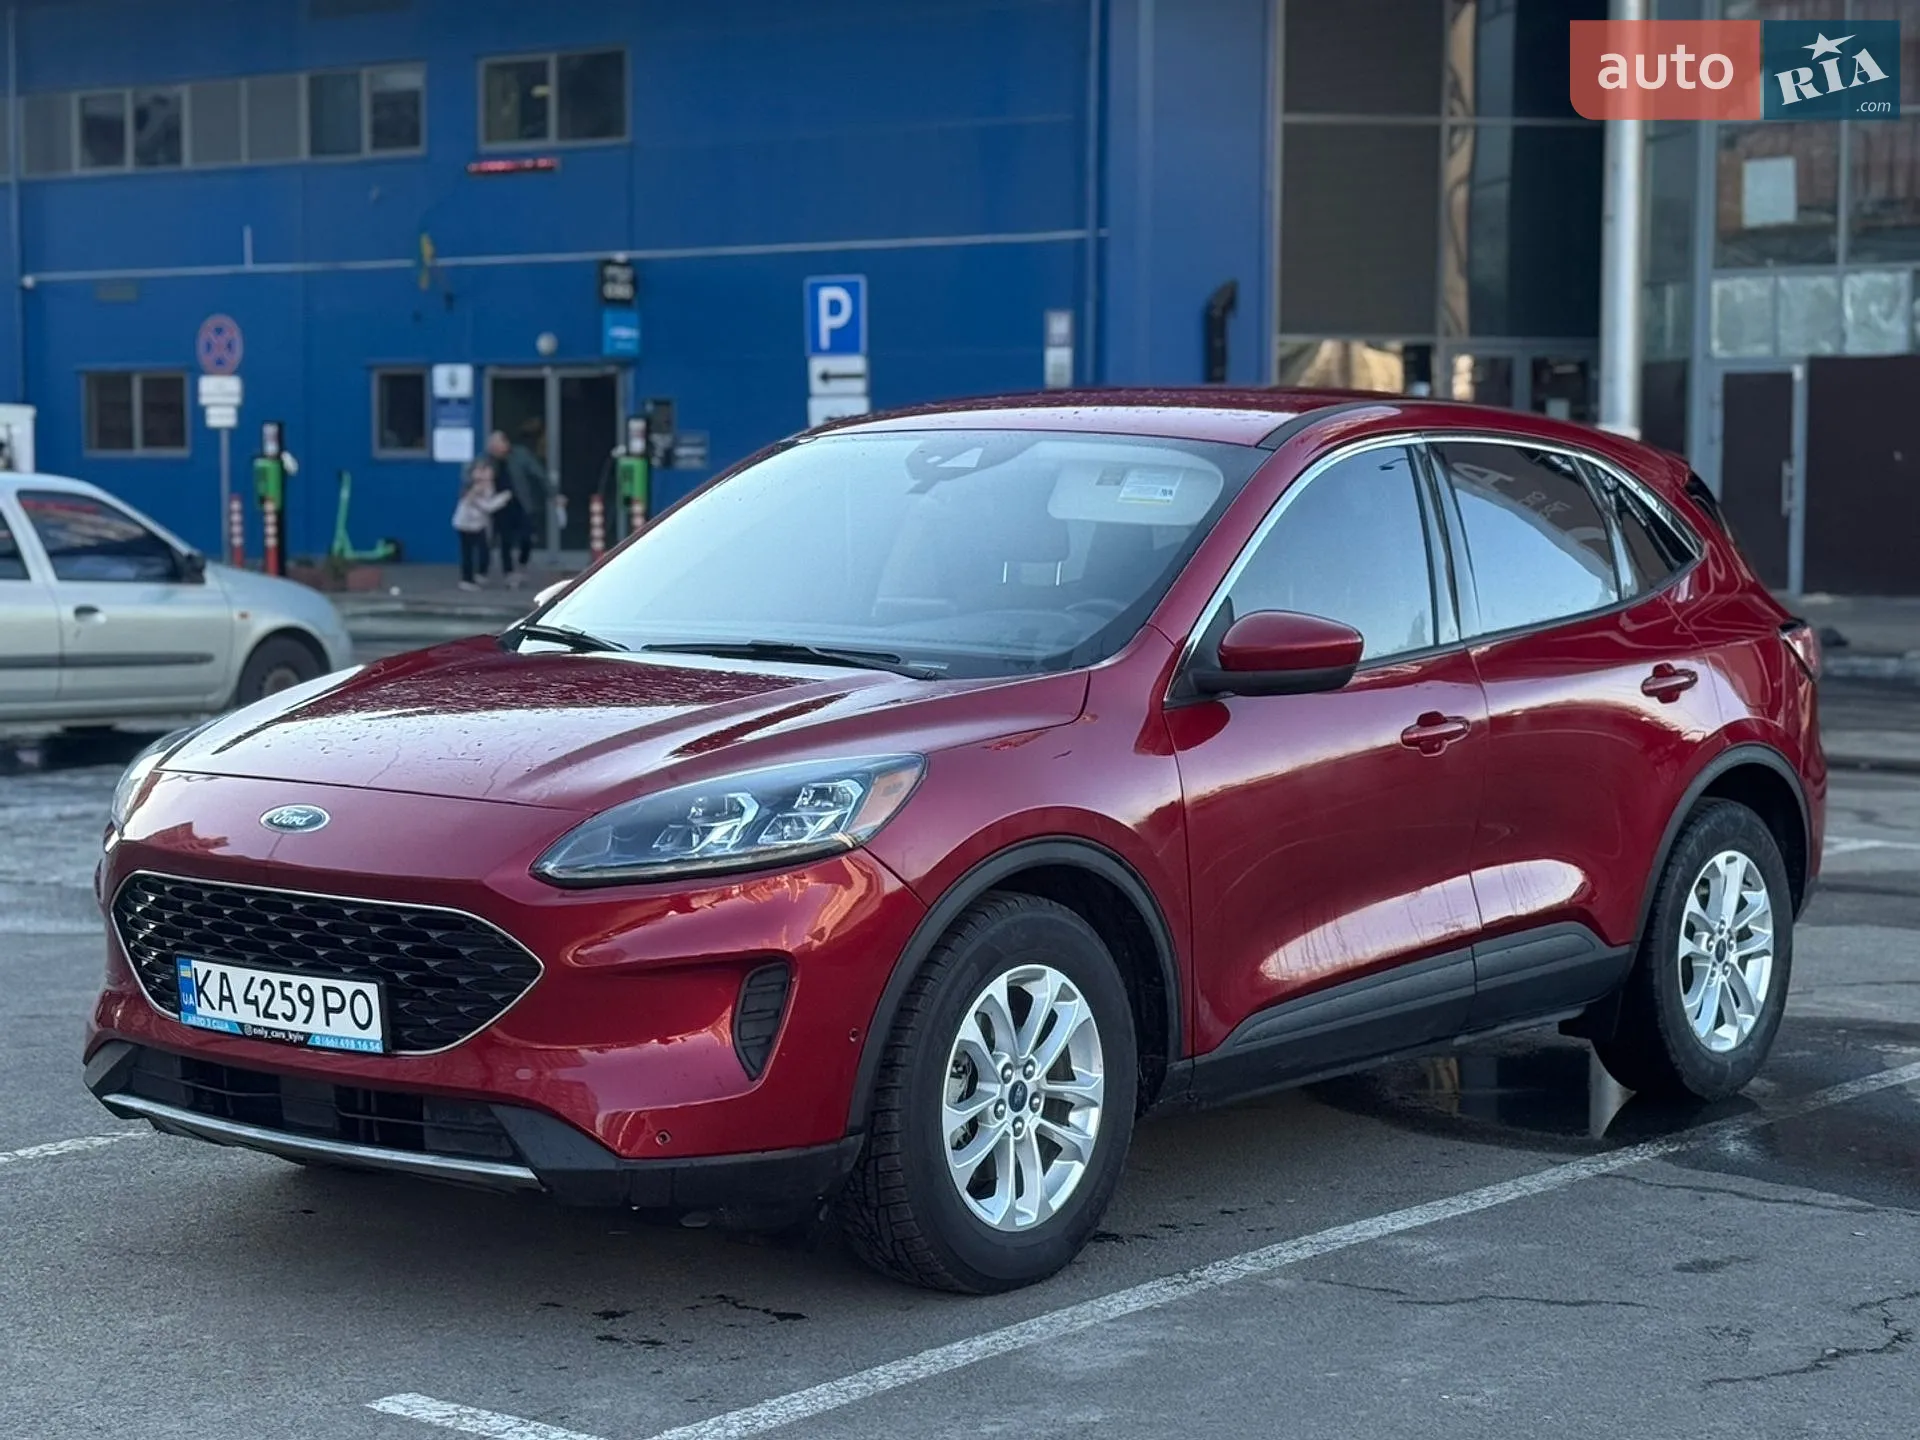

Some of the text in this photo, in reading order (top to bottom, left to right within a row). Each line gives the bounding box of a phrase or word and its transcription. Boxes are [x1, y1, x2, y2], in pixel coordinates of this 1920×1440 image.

[818, 286, 853, 350] P
[273, 809, 313, 826] Ford
[182, 993, 195, 1006] UA
[193, 967, 374, 1031] KA 4259 PO
